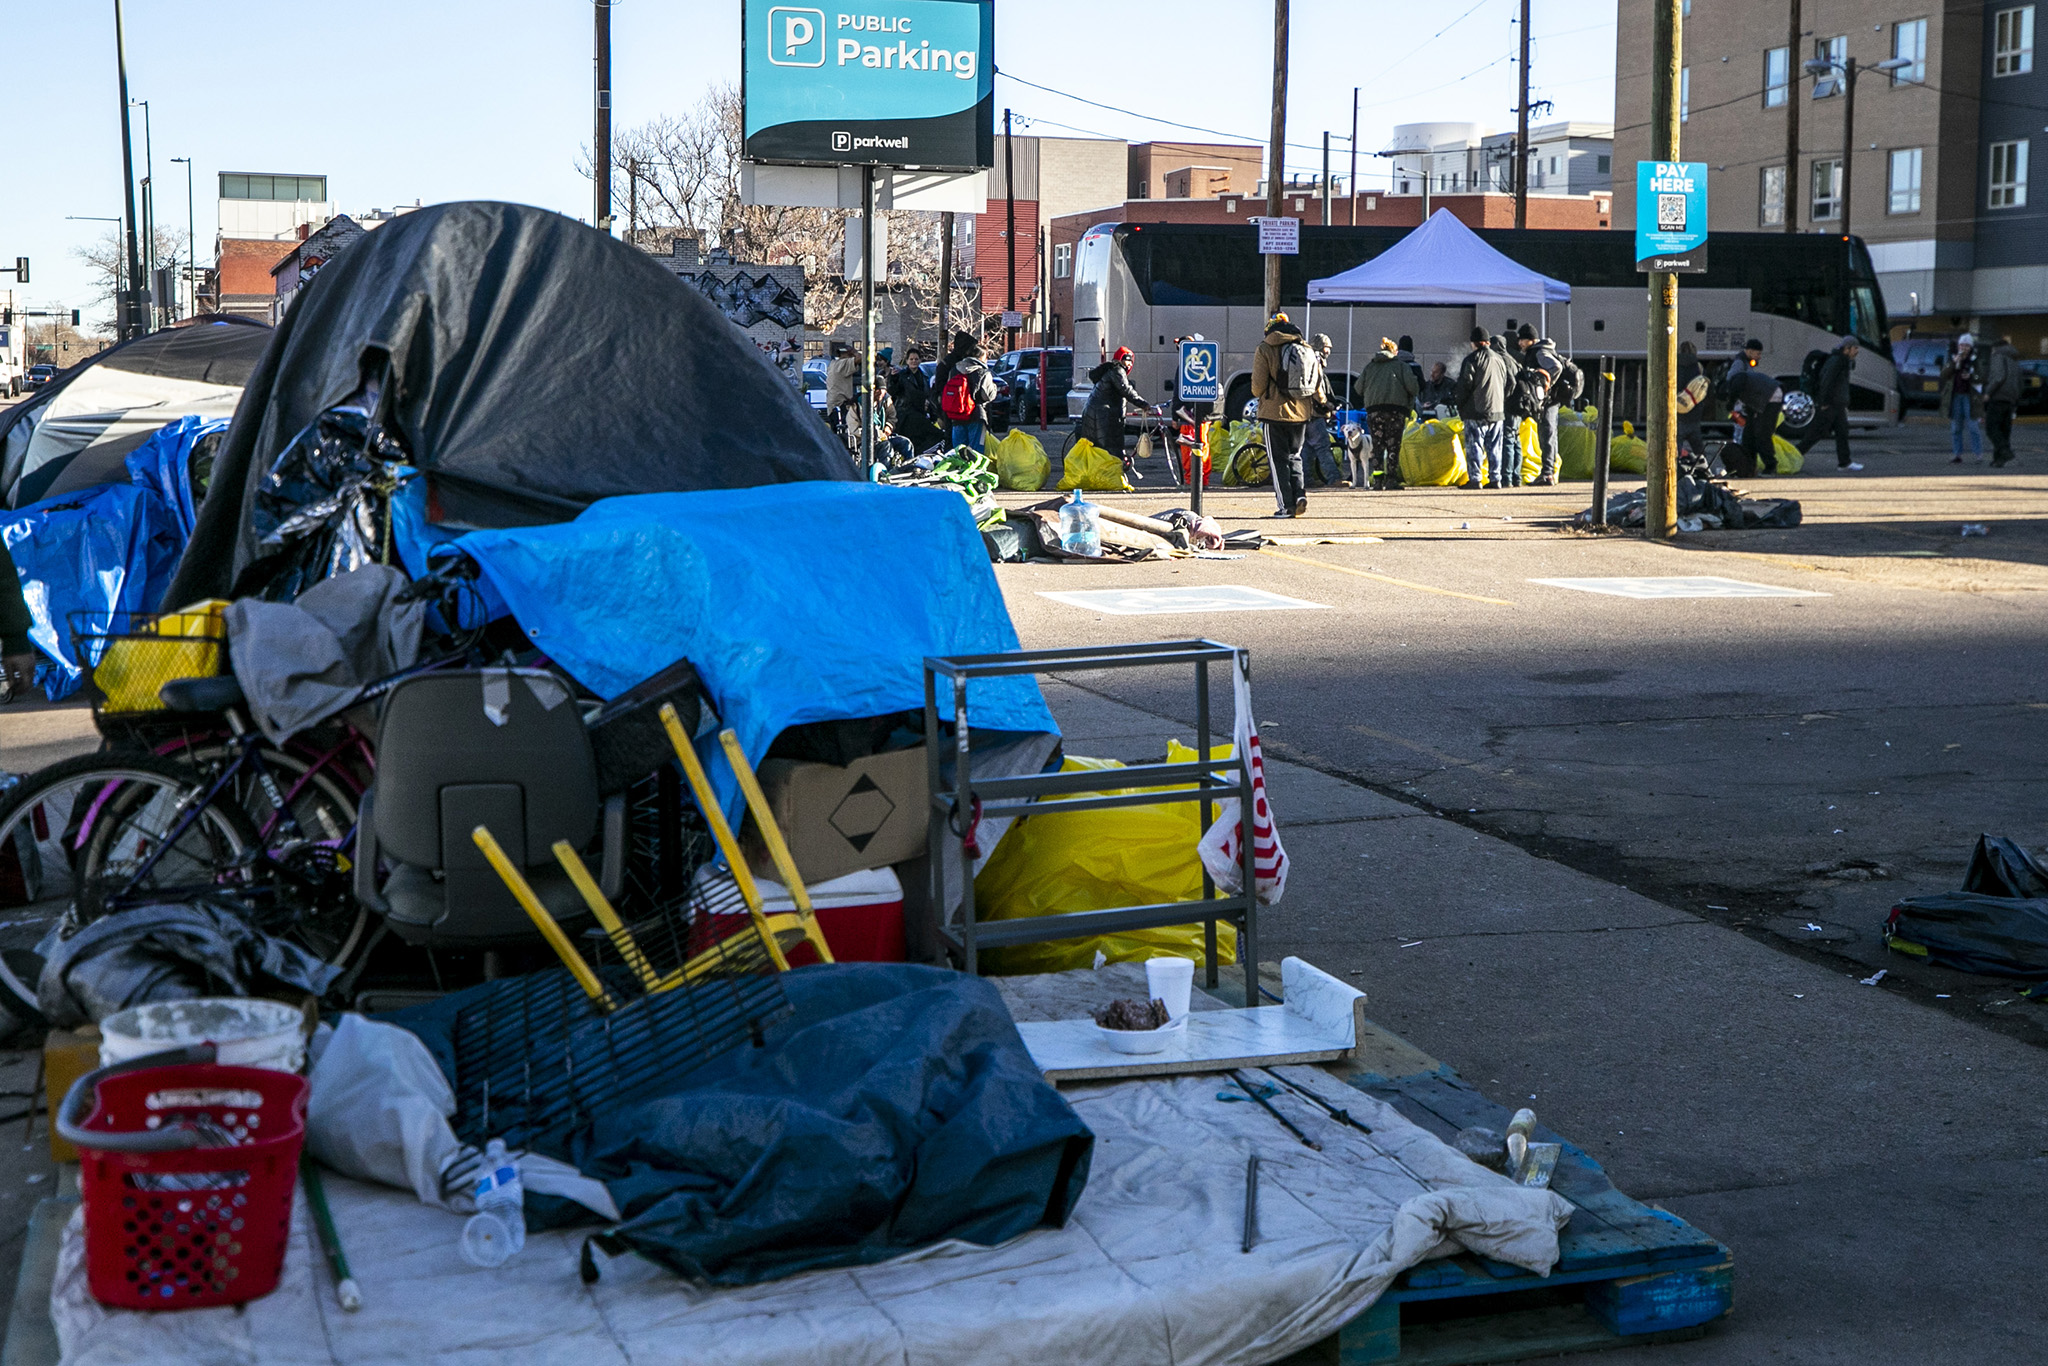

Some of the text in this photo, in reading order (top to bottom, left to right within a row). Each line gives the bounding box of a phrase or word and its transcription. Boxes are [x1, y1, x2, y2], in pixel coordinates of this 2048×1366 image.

[837, 13, 912, 34] PUBLIC
[837, 39, 977, 80] Parking
[853, 135, 909, 150] parkwell
[1656, 163, 1689, 178] PAY
[1650, 178, 1695, 193] HERE
[1663, 260, 1690, 268] parkwell
[1183, 385, 1216, 396] PARKING
